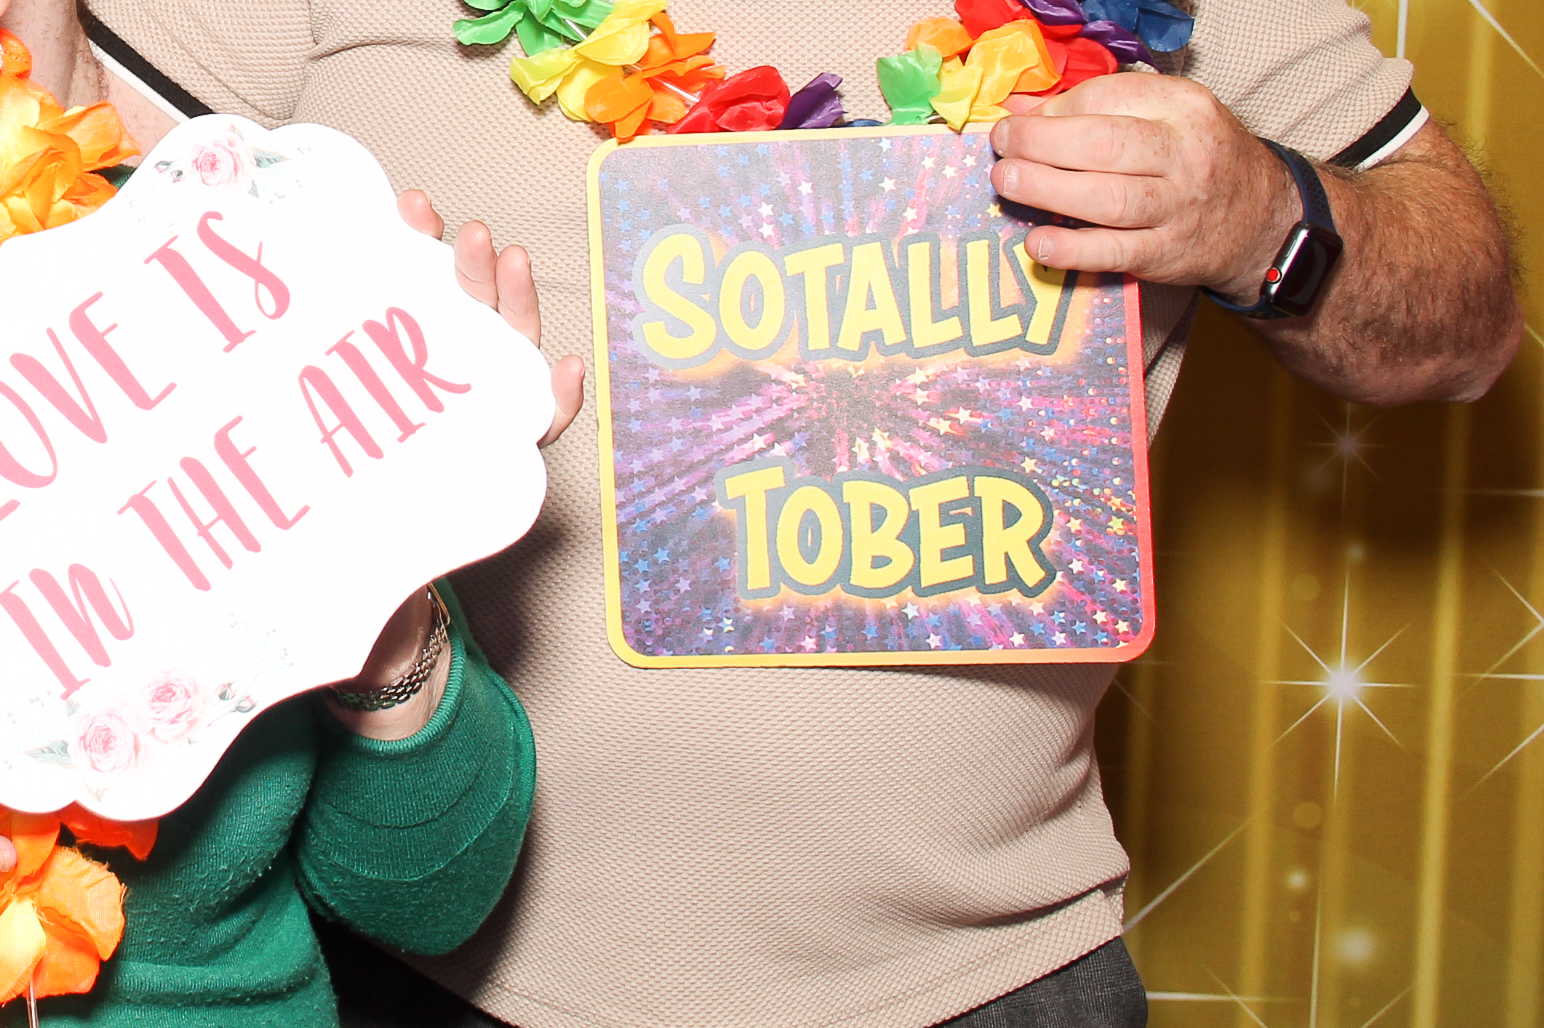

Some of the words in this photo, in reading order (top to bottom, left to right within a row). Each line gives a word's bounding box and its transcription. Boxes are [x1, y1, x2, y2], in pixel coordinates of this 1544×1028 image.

[143, 211, 291, 353] IS
[636, 227, 1077, 366] SOTALLY
[117, 416, 311, 592] THE
[298, 306, 472, 479] AIR
[720, 461, 1054, 595] TOBER
